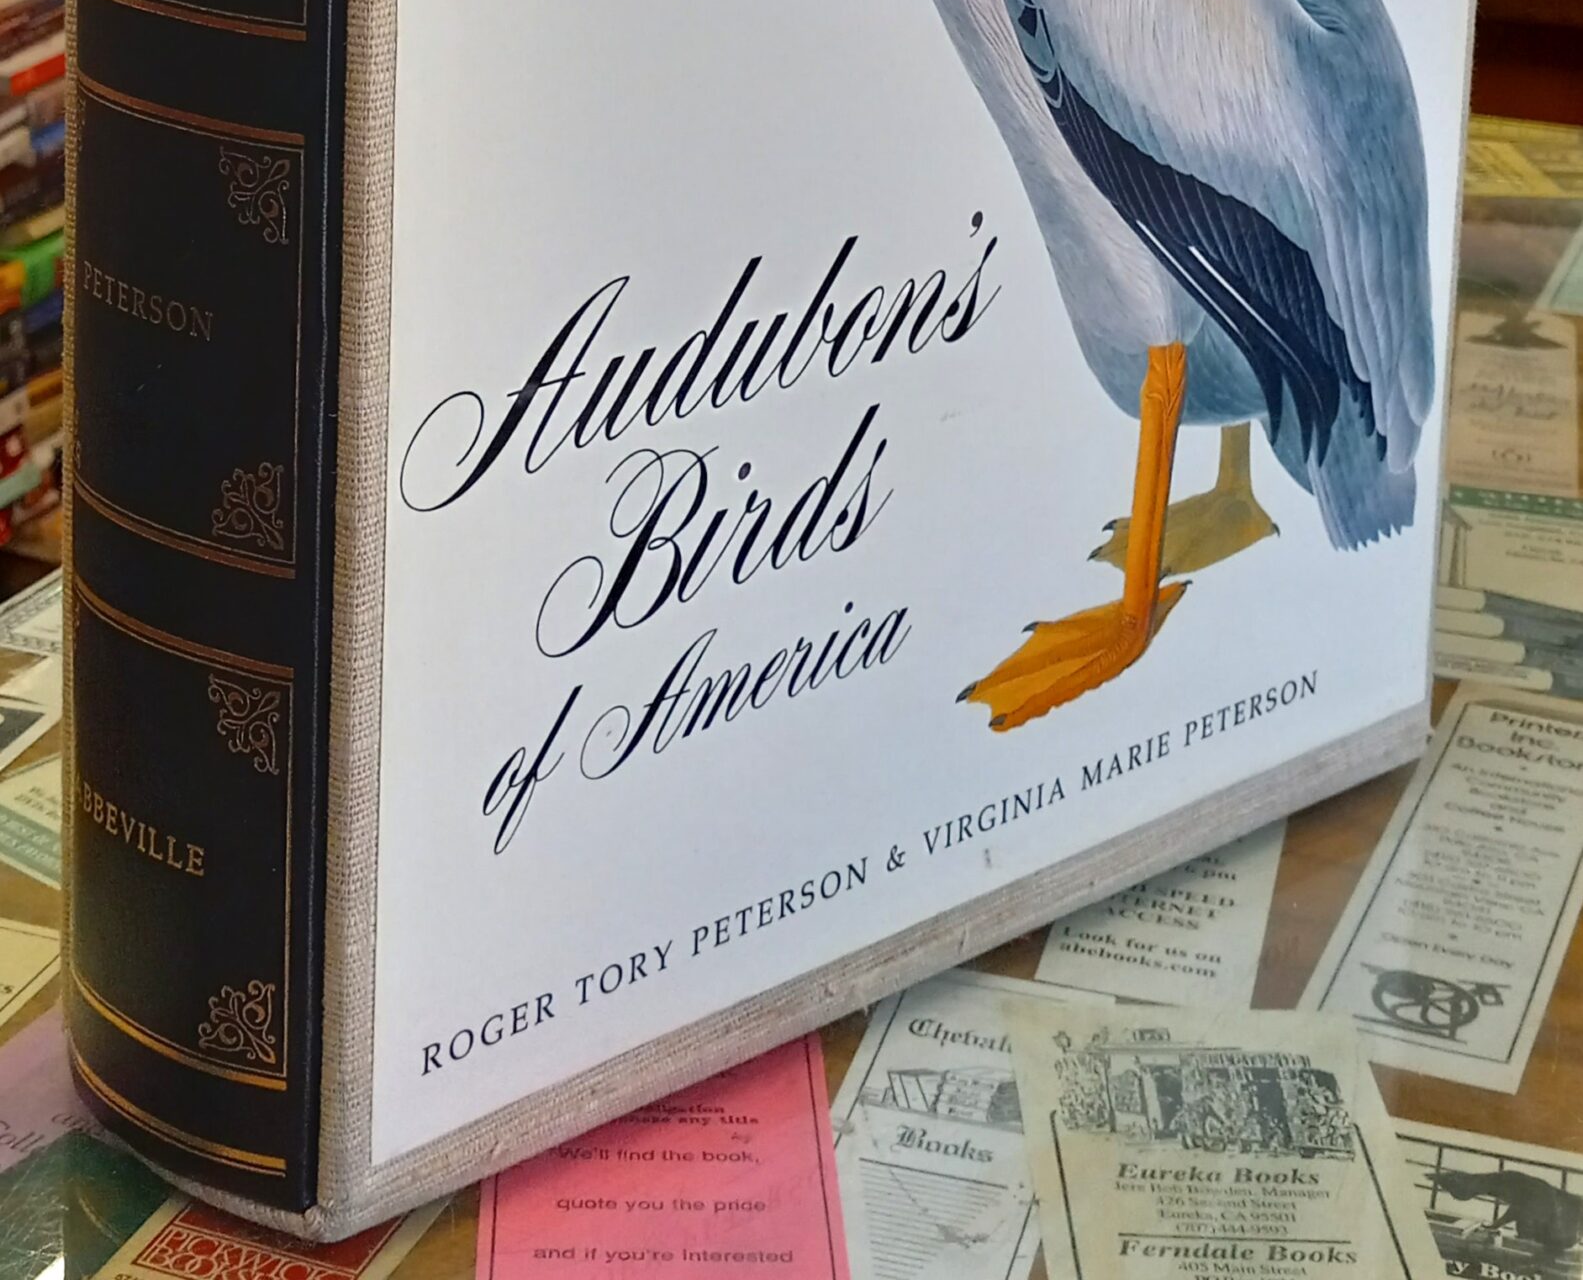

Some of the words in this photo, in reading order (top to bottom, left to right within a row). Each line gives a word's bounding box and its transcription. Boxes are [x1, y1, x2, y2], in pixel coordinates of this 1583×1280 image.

[83, 260, 213, 342] PETERSON
[400, 211, 1001, 512] Audubon's
[536, 403, 894, 658] Birds
[483, 684, 583, 855] of
[580, 601, 912, 780] America
[1490, 711, 1583, 739] Printer
[1457, 735, 1583, 770] Bookstor
[422, 993, 555, 1076] ROGER
[575, 940, 672, 1005] TORY
[692, 857, 867, 957] PETERSON
[887, 845, 906, 872] &
[923, 778, 1065, 855] VIRGINIA
[1082, 731, 1170, 790] MARIE
[1184, 670, 1317, 746] PETERSON
[1110, 892, 1219, 919] TERNET
[1063, 926, 1117, 945] Look
[1126, 937, 1160, 953] for
[1165, 946, 1188, 959] us
[1195, 952, 1222, 965] on
[556, 1146, 609, 1161] We'll
[617, 1148, 655, 1162] find
[662, 1149, 694, 1162] the
[895, 1124, 994, 1163] Books
[1118, 1162, 1222, 1182] Eureka
[1234, 1167, 1320, 1185] Books
[557, 1198, 617, 1212] quote
[625, 1199, 665, 1212] you
[673, 1198, 706, 1212] the
[713, 1199, 766, 1214] price
[1251, 1199, 1297, 1210] Street
[533, 1247, 575, 1261] and
[584, 1247, 598, 1261] if
[605, 1249, 674, 1263] you're
[682, 1249, 794, 1264] interested
[1118, 1239, 1254, 1260] Ferndale
[1268, 1245, 1358, 1264] Books
